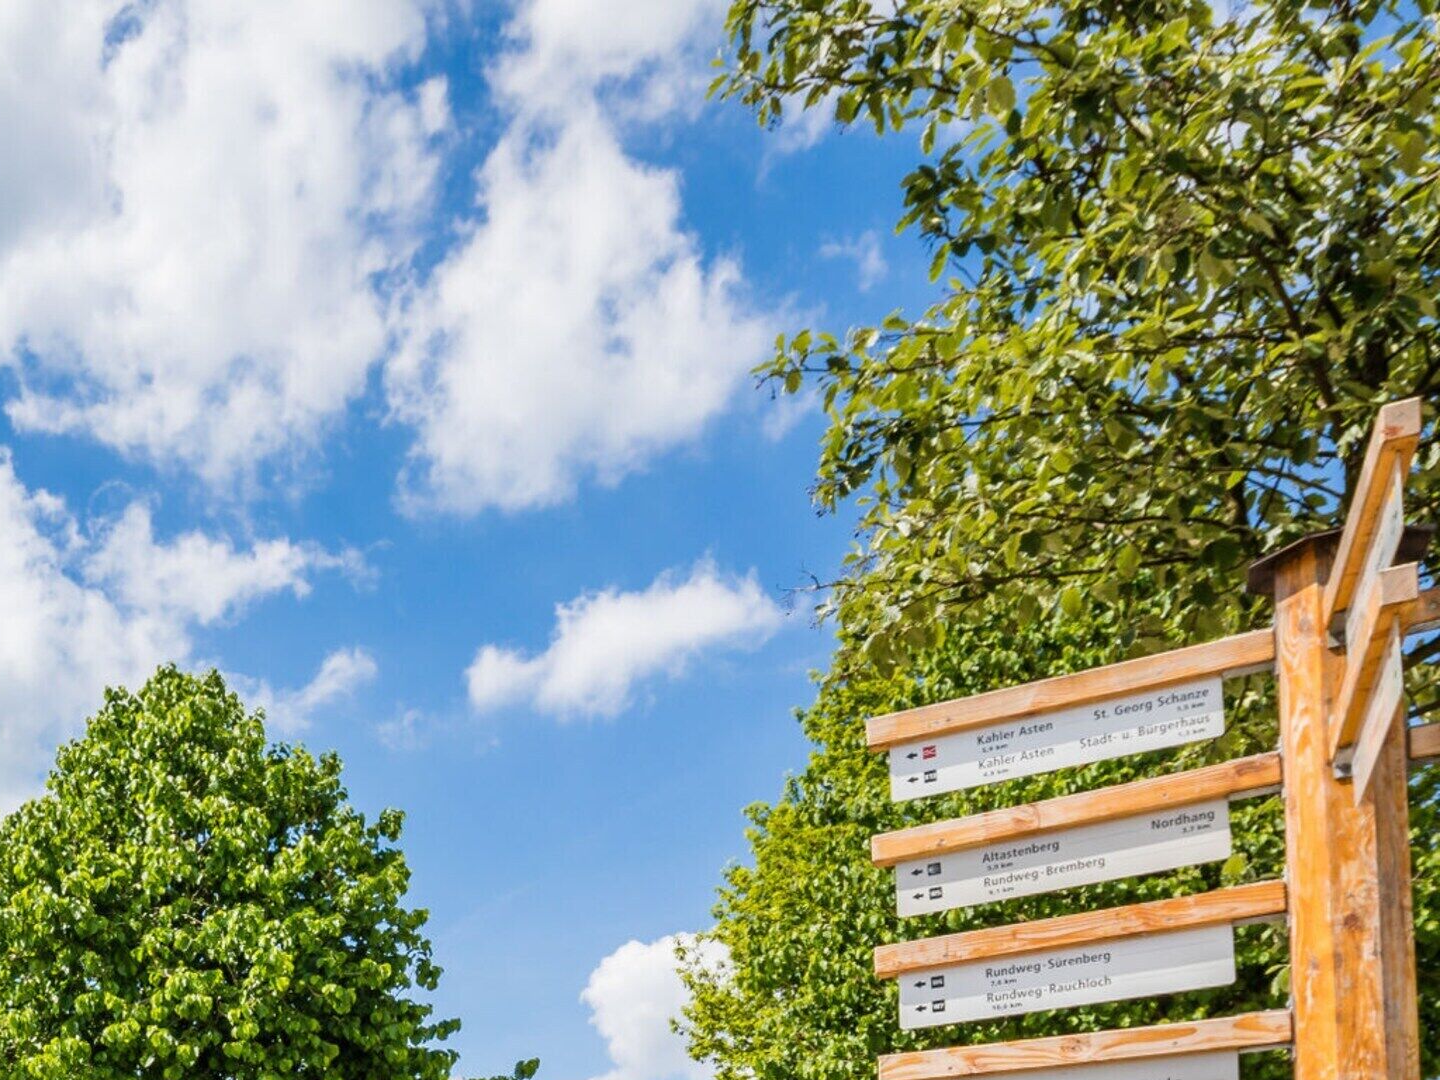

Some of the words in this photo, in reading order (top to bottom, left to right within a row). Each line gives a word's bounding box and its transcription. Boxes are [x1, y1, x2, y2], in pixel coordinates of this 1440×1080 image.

[1114, 700, 1153, 717] Georg
[1157, 688, 1209, 707] Schanze
[976, 730, 1014, 745] Kahler
[1019, 722, 1053, 737] Asten
[977, 755, 1015, 769] Kahler
[1020, 747, 1055, 762] Asten
[1151, 810, 1215, 830] Nordhang
[982, 840, 1060, 863] Altastenberg
